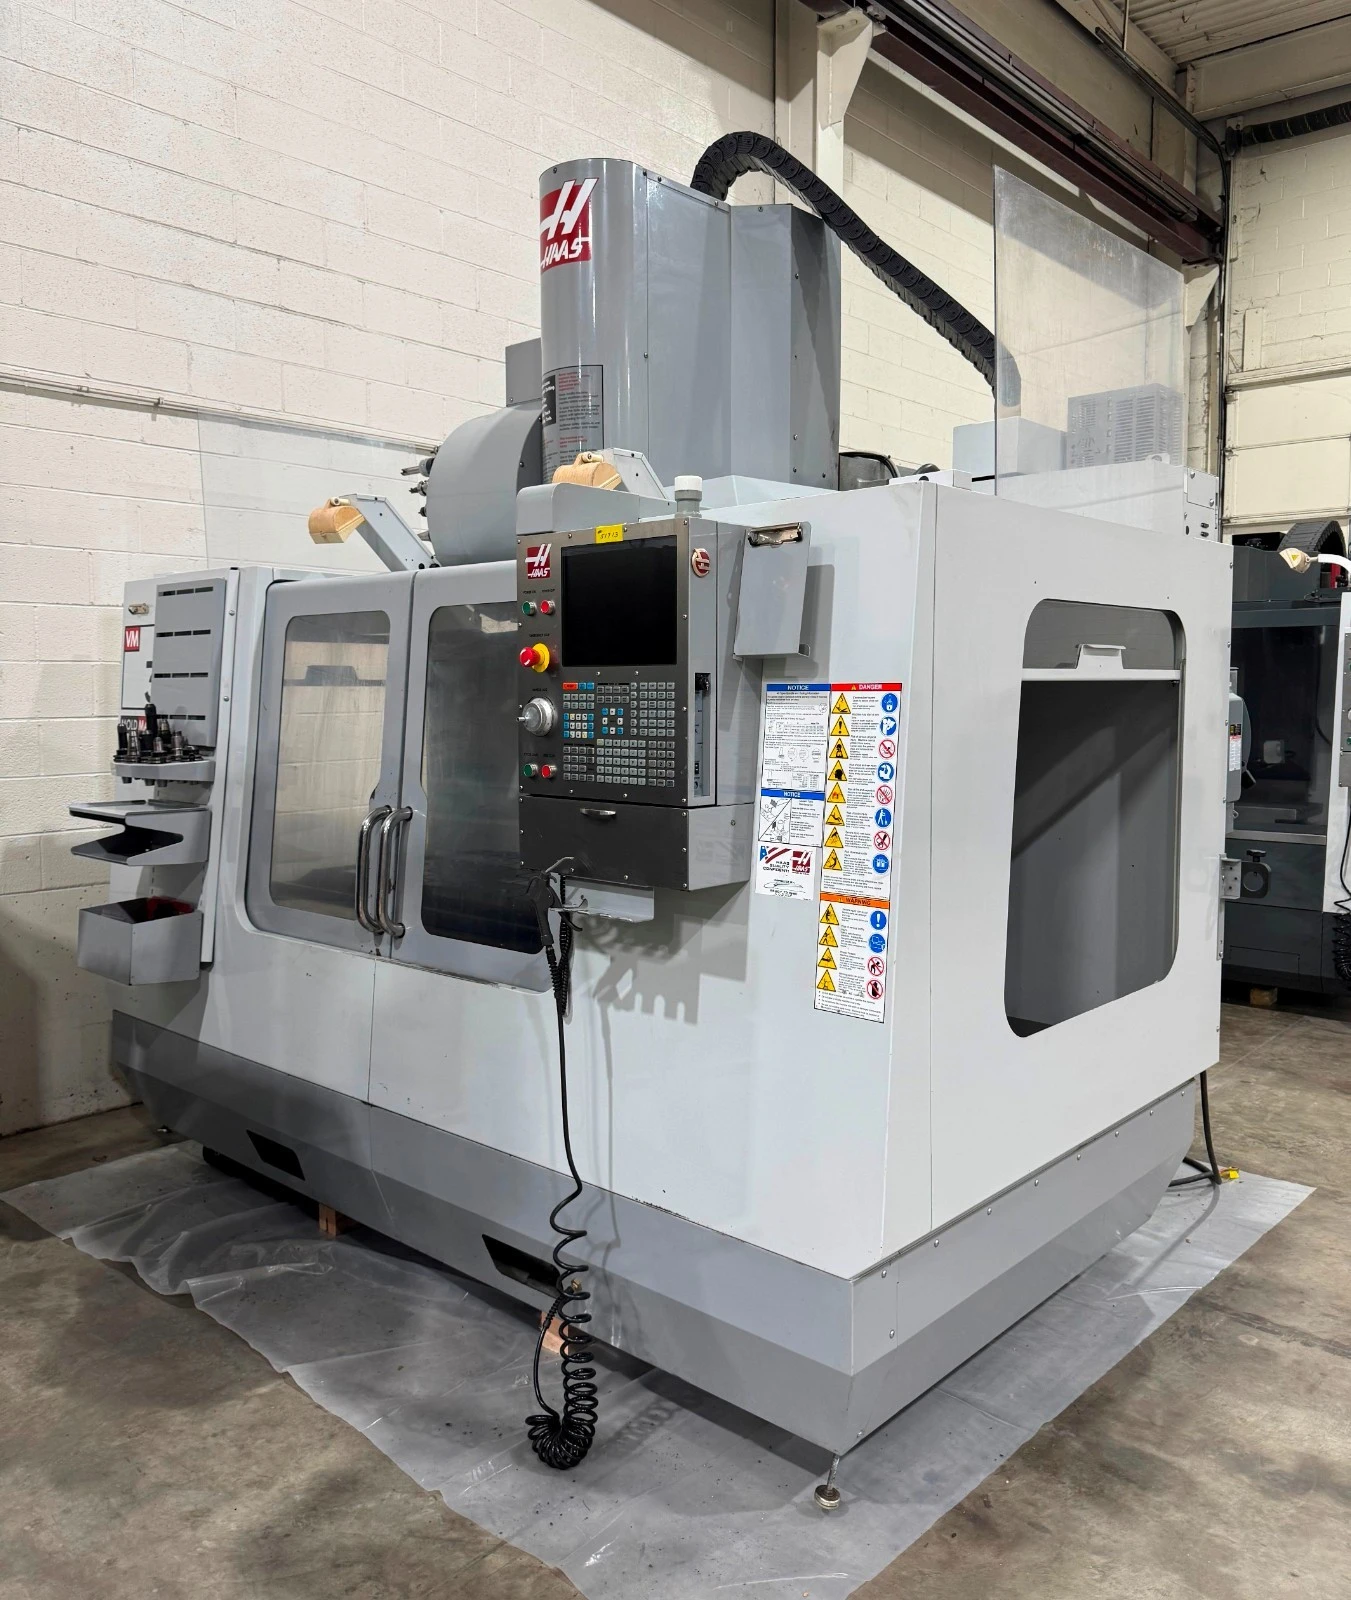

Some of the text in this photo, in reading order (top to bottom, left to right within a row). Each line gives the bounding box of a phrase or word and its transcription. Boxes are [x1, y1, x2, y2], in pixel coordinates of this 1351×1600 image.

[541, 237, 591, 269] HAAS
[527, 567, 551, 578] HAAS
[126, 630, 139, 647] VM
[858, 683, 883, 691] DANGER
[845, 897, 871, 906] WARNING
